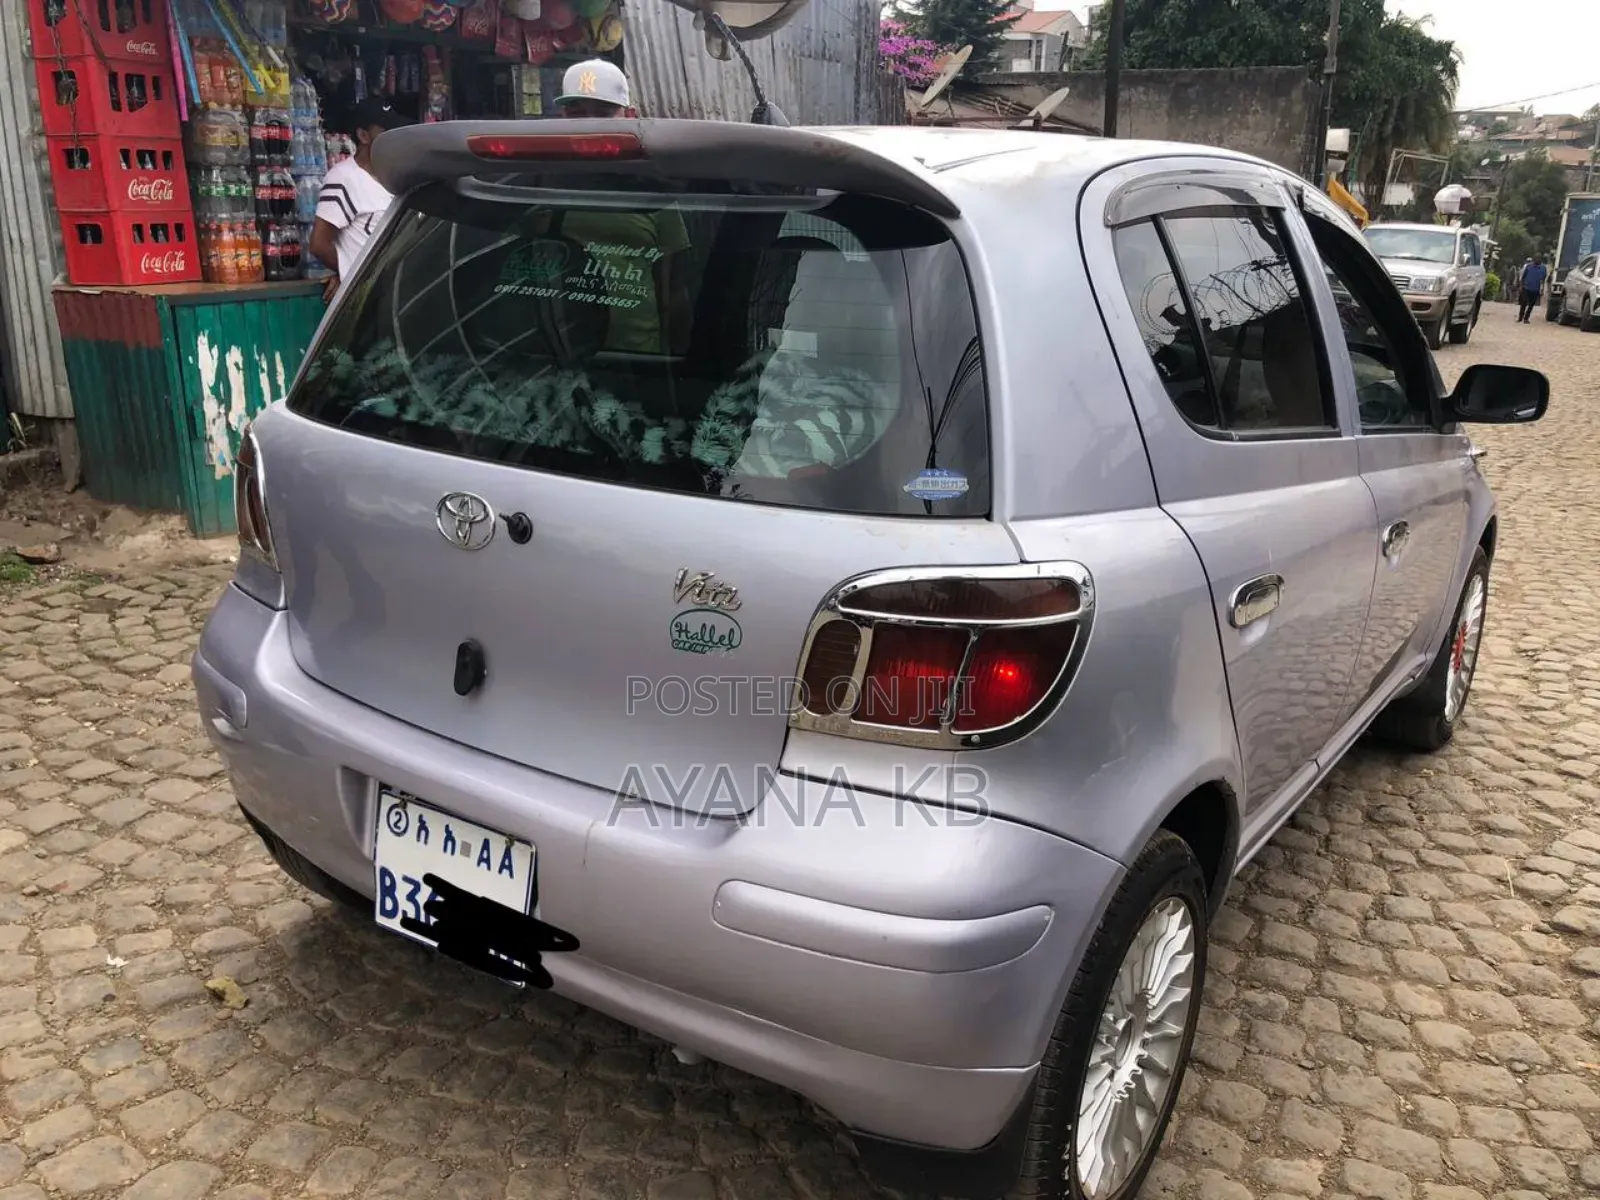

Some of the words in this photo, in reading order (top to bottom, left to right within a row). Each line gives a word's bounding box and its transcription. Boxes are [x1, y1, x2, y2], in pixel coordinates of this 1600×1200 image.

[583, 241, 645, 257] Supplied
[644, 247, 664, 263] By
[673, 566, 742, 611] Vitz
[674, 620, 736, 649] Hallel
